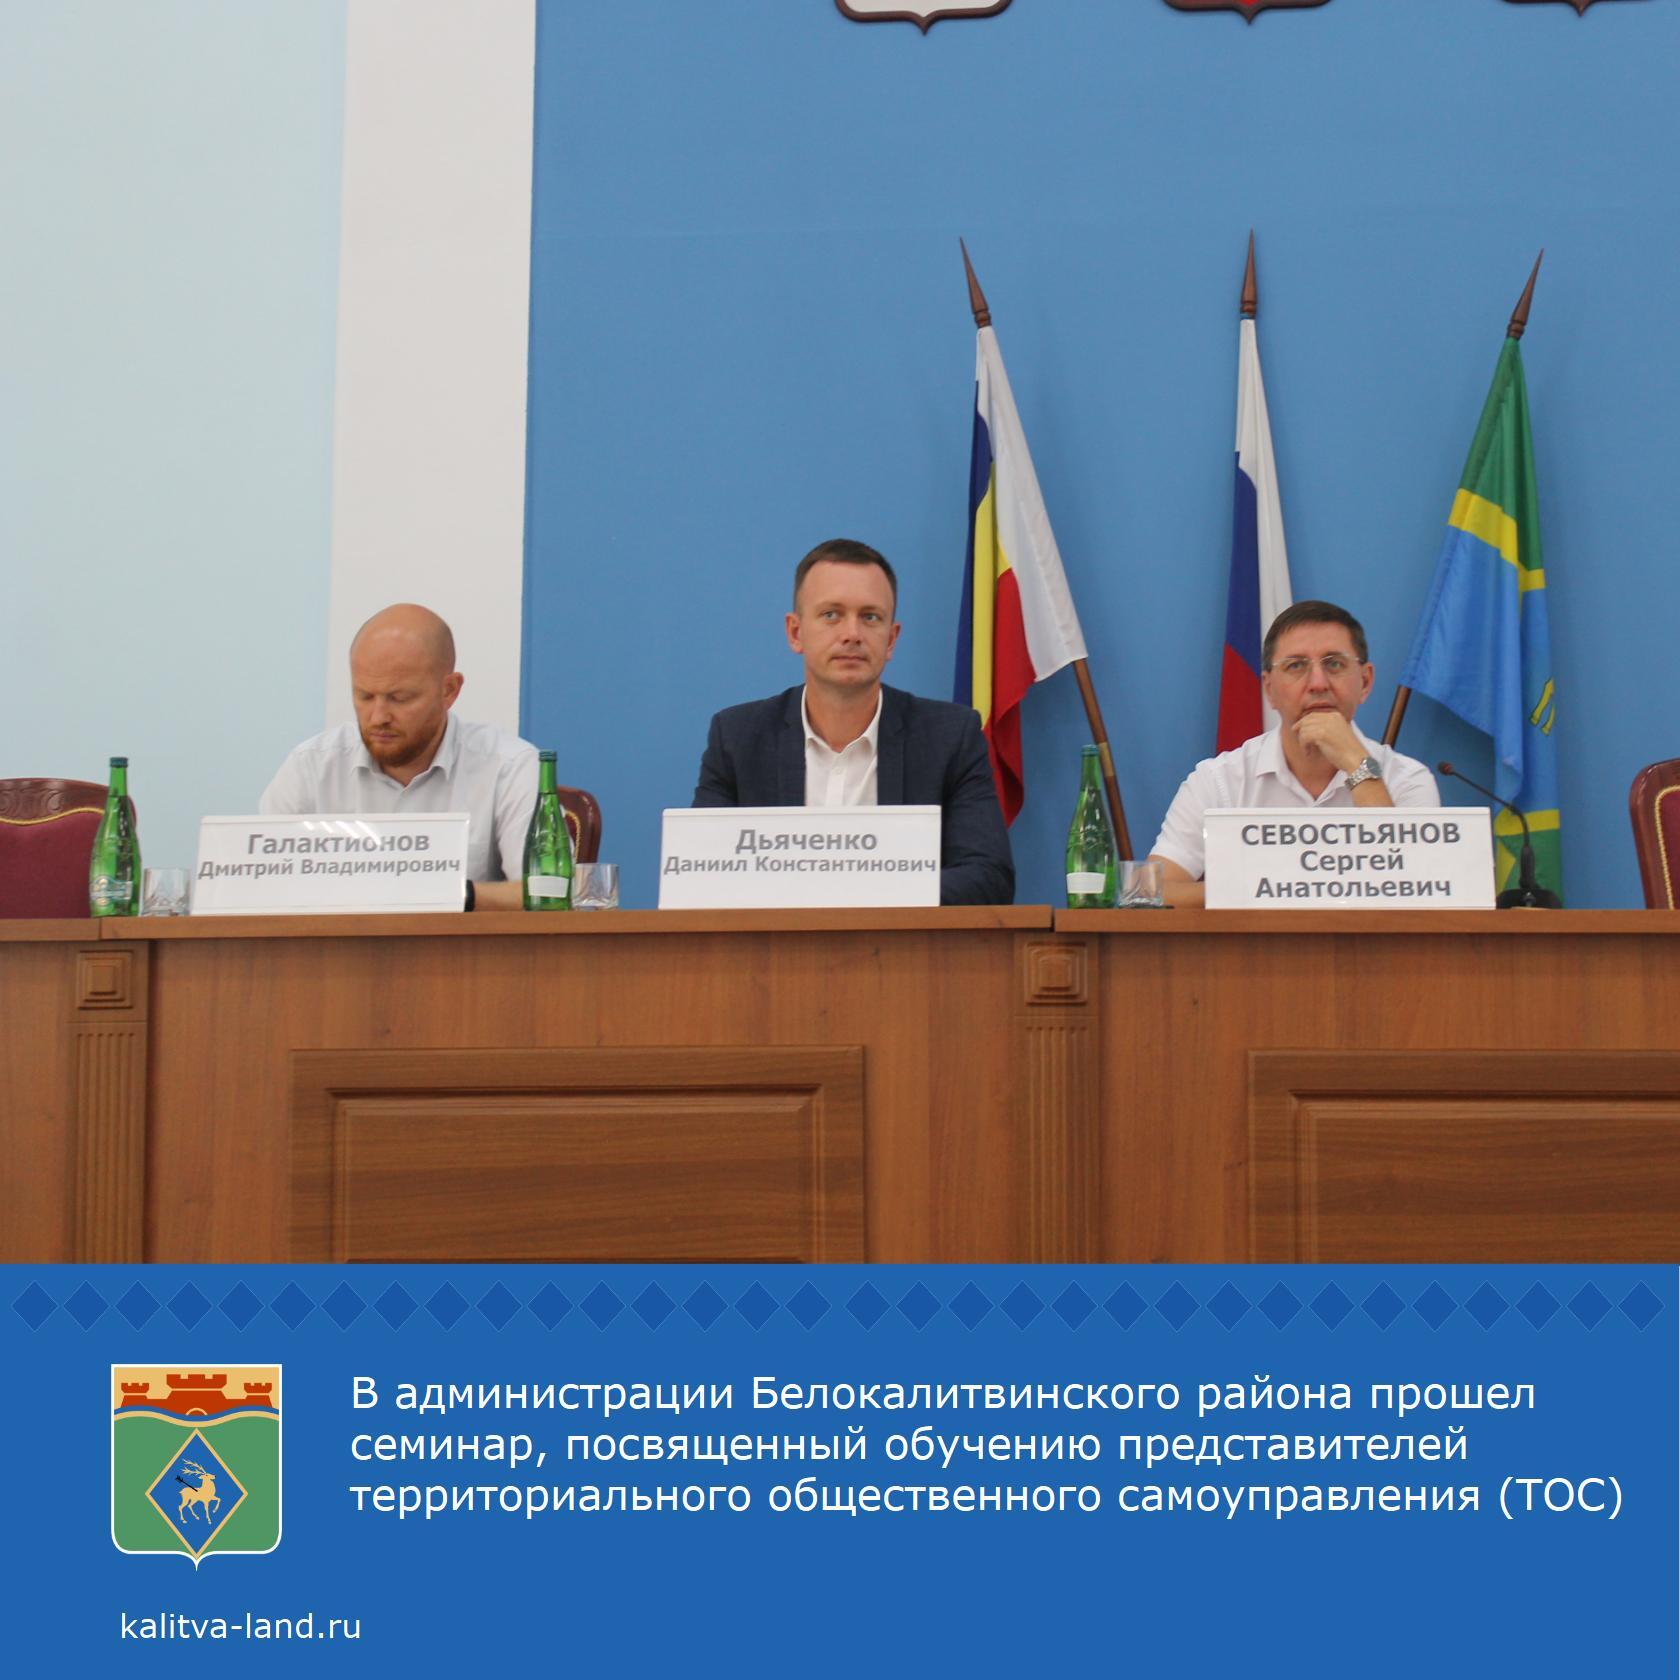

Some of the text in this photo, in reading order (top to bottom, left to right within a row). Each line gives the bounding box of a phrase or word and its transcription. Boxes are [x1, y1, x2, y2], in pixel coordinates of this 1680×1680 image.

[248, 833, 430, 855] Галактионов
[735, 829, 878, 855] Дьяченко
[1241, 822, 1461, 846] СЕВОСТЬЯНОВ
[198, 858, 461, 880] Дмитрий Владимирович
[663, 855, 937, 876] Даниил Константинович
[1300, 847, 1404, 875] Сергей
[1255, 877, 1451, 899] Анатольевич
